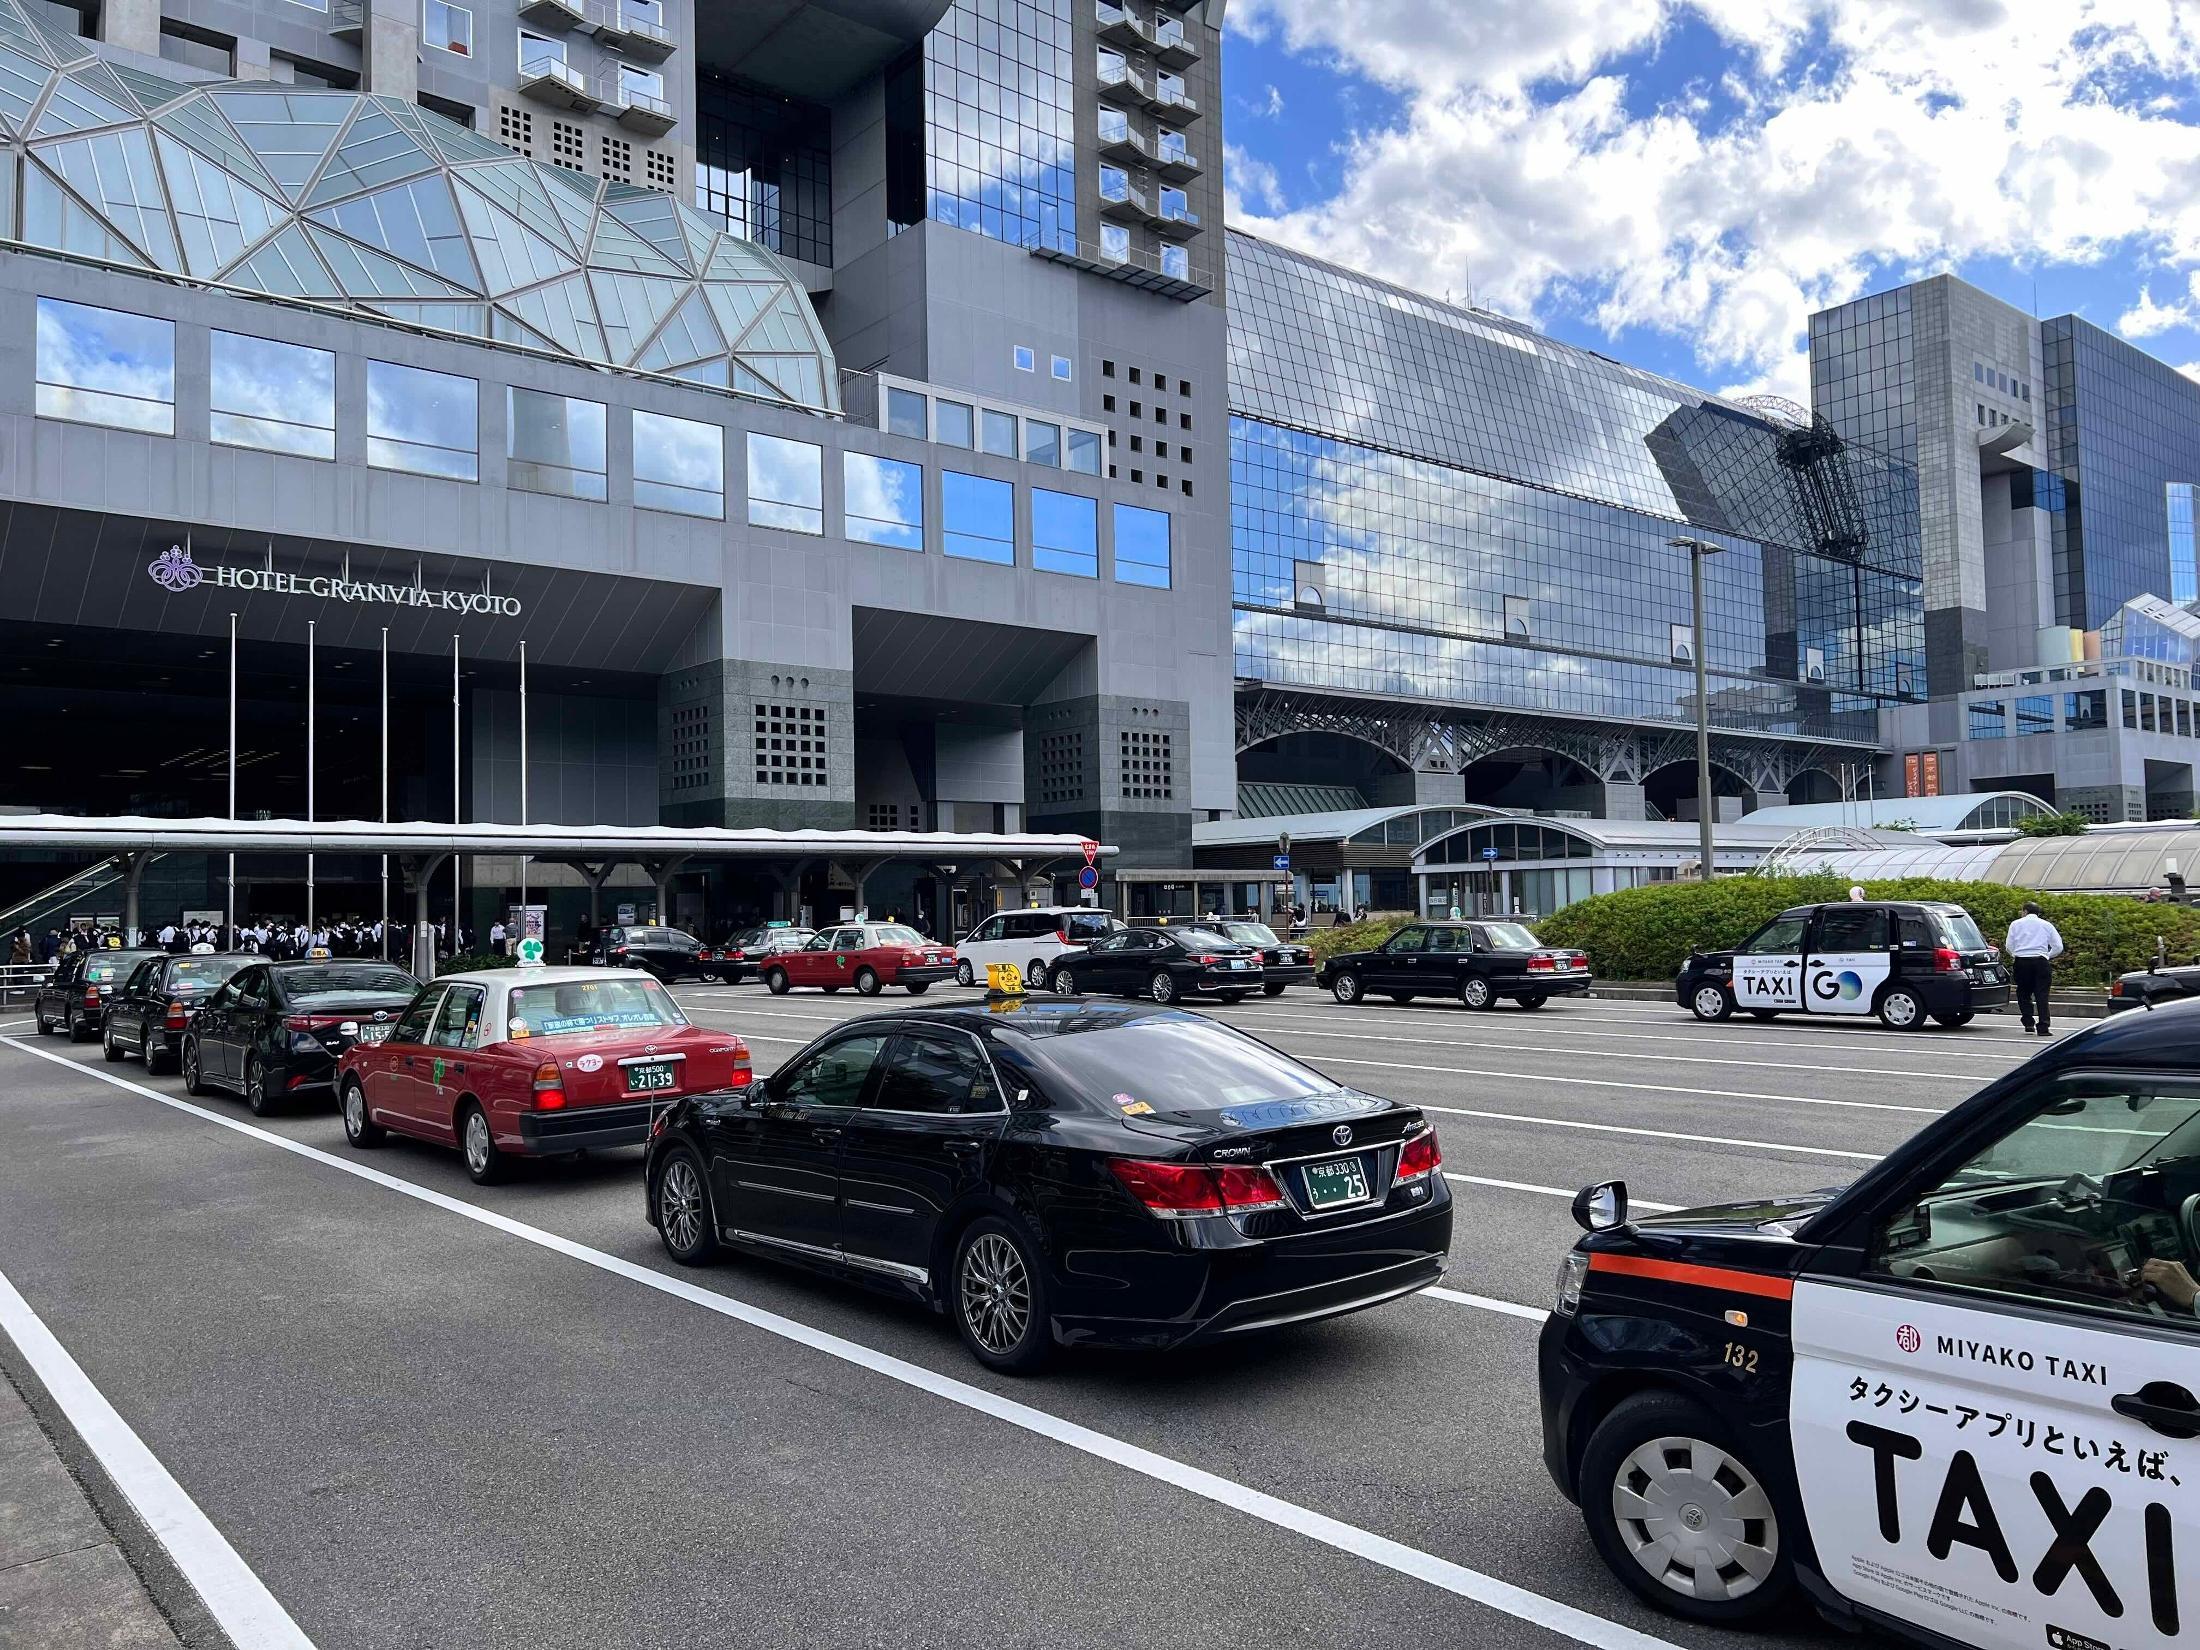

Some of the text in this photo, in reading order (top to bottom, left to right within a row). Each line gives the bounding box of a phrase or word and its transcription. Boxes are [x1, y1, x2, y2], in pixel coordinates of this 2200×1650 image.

[216, 565, 522, 617] HOTEL GRANVIA KYOTO
[1743, 976, 1792, 996] TAXI
[1813, 970, 1862, 1000] GO
[1214, 1146, 1251, 1158] CROWN
[1318, 1162, 1349, 1178] 京都330
[1724, 1342, 1758, 1374] 132
[1937, 1336, 2107, 1386] MIYAKO TAXI
[1850, 1376, 2181, 1487] タクシーアプリといえば、
[1846, 1420, 2180, 1636] TAXI
[2066, 1635, 2082, 1646] App
